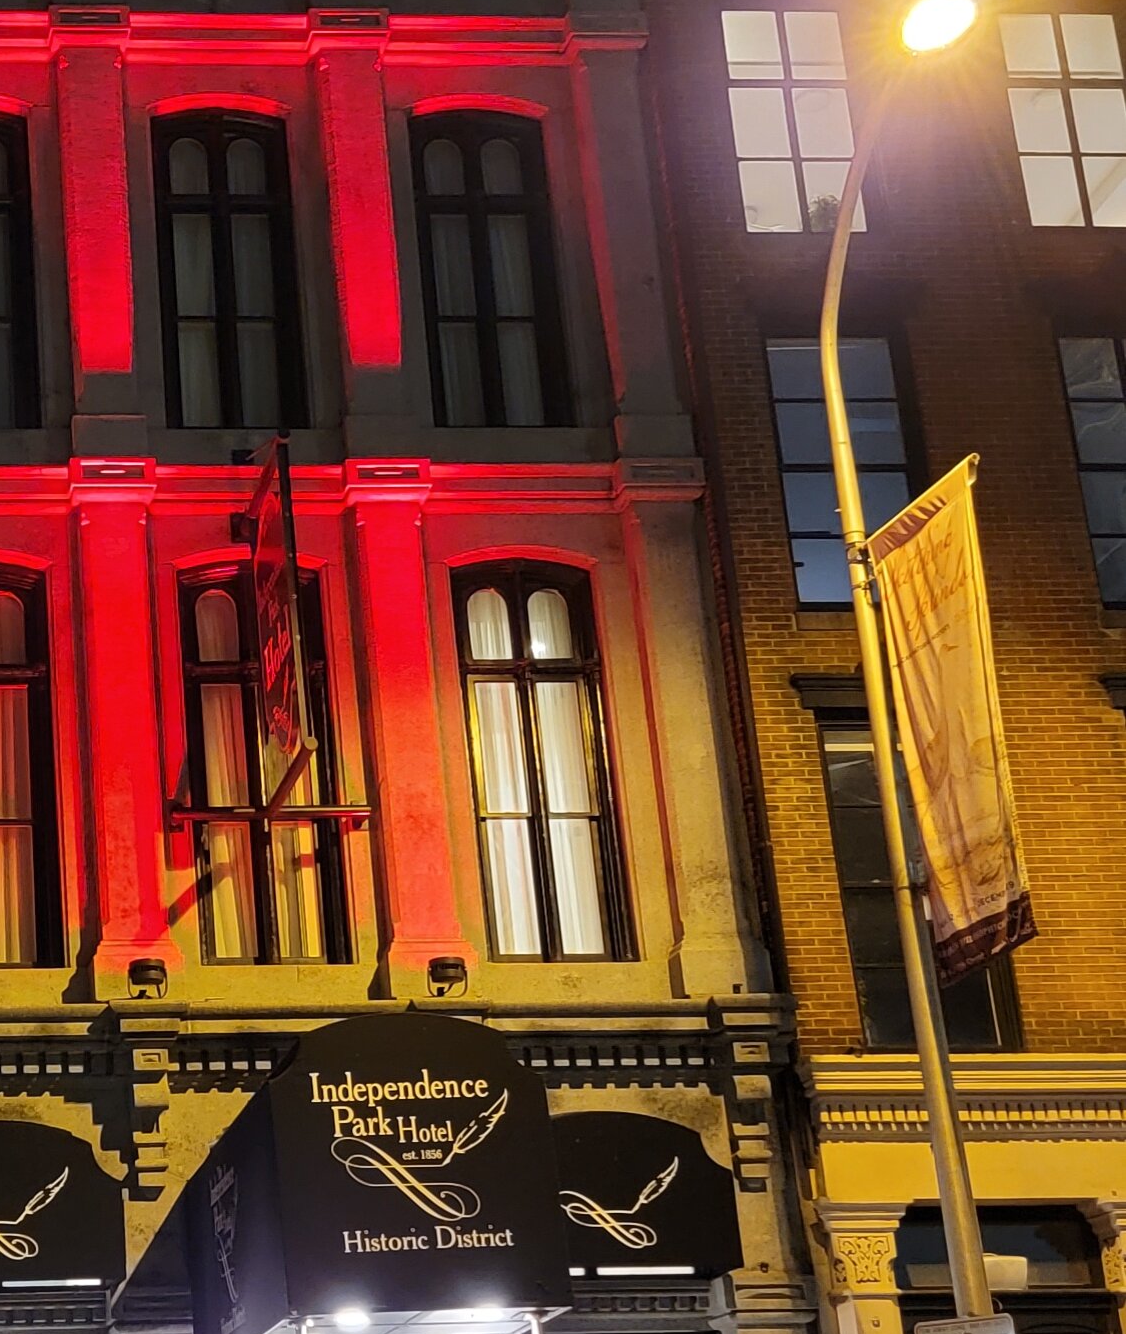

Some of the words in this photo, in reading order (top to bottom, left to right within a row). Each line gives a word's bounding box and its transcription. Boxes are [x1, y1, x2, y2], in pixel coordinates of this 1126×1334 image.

[309, 1069, 490, 1107] Independence
[331, 1105, 394, 1138] Park
[396, 1116, 454, 1144] Hotel
[402, 1150, 419, 1161] est.
[421, 1149, 443, 1160] 1856
[342, 1227, 430, 1253] Historic
[434, 1224, 515, 1249] District
